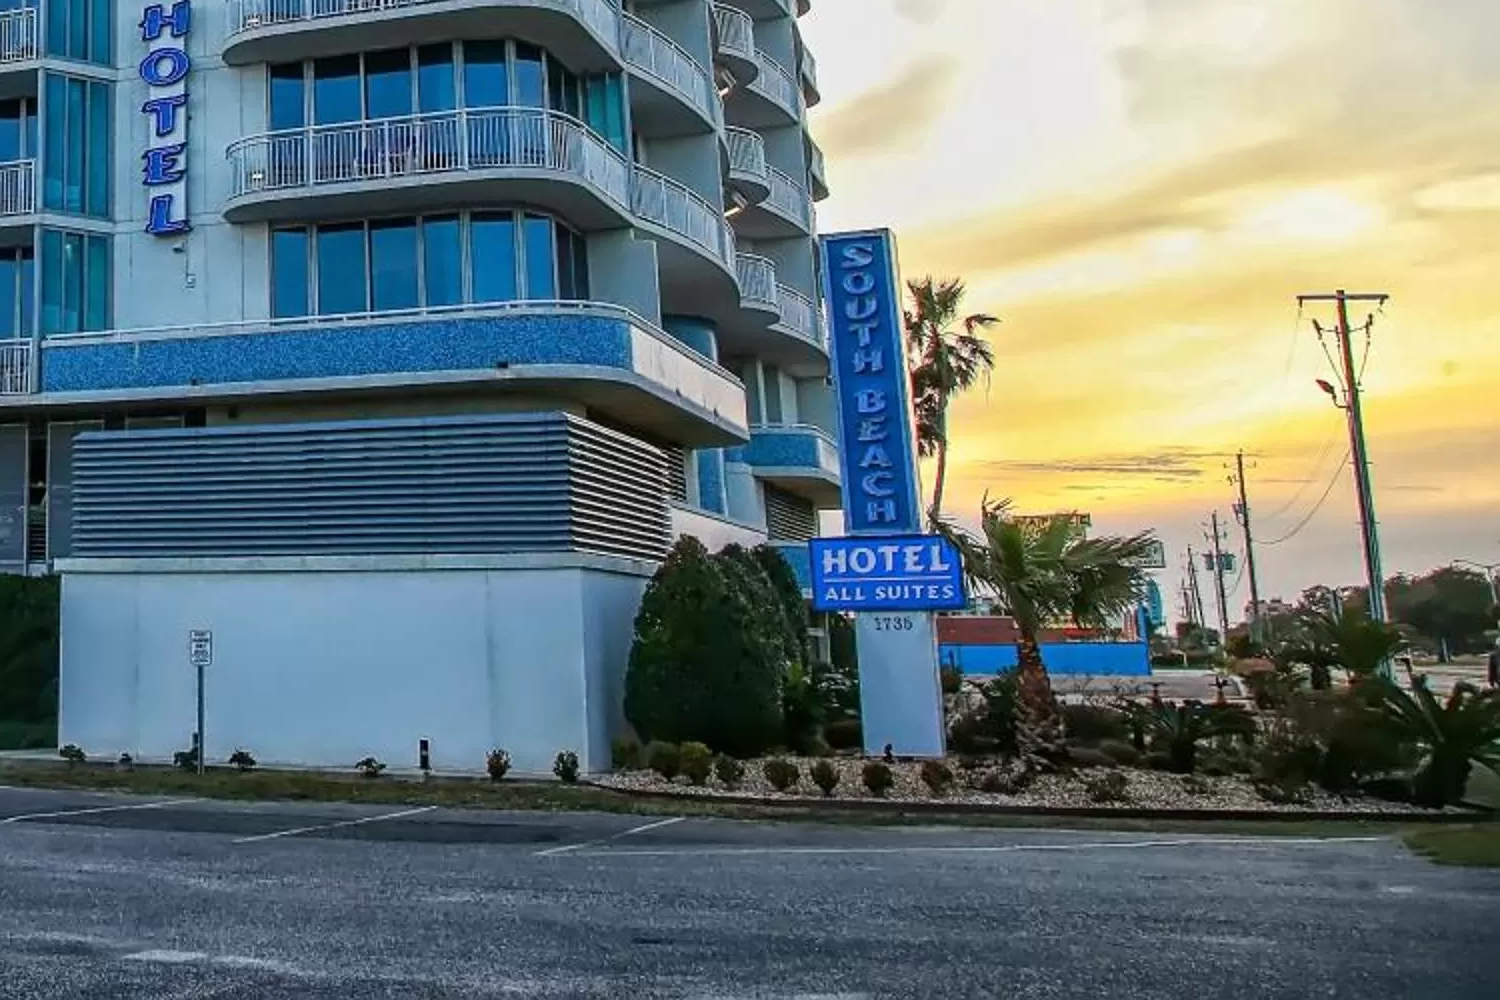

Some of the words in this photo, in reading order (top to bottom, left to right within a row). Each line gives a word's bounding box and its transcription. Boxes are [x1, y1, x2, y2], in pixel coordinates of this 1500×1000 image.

[139, 0, 191, 235] HOTEL
[841, 243, 883, 374] SOUTH
[854, 389, 897, 523] BEACH
[822, 545, 951, 575] HOTEL
[825, 587, 866, 601] ALL
[875, 585, 955, 600] SUITES
[874, 616, 914, 631] 1735
